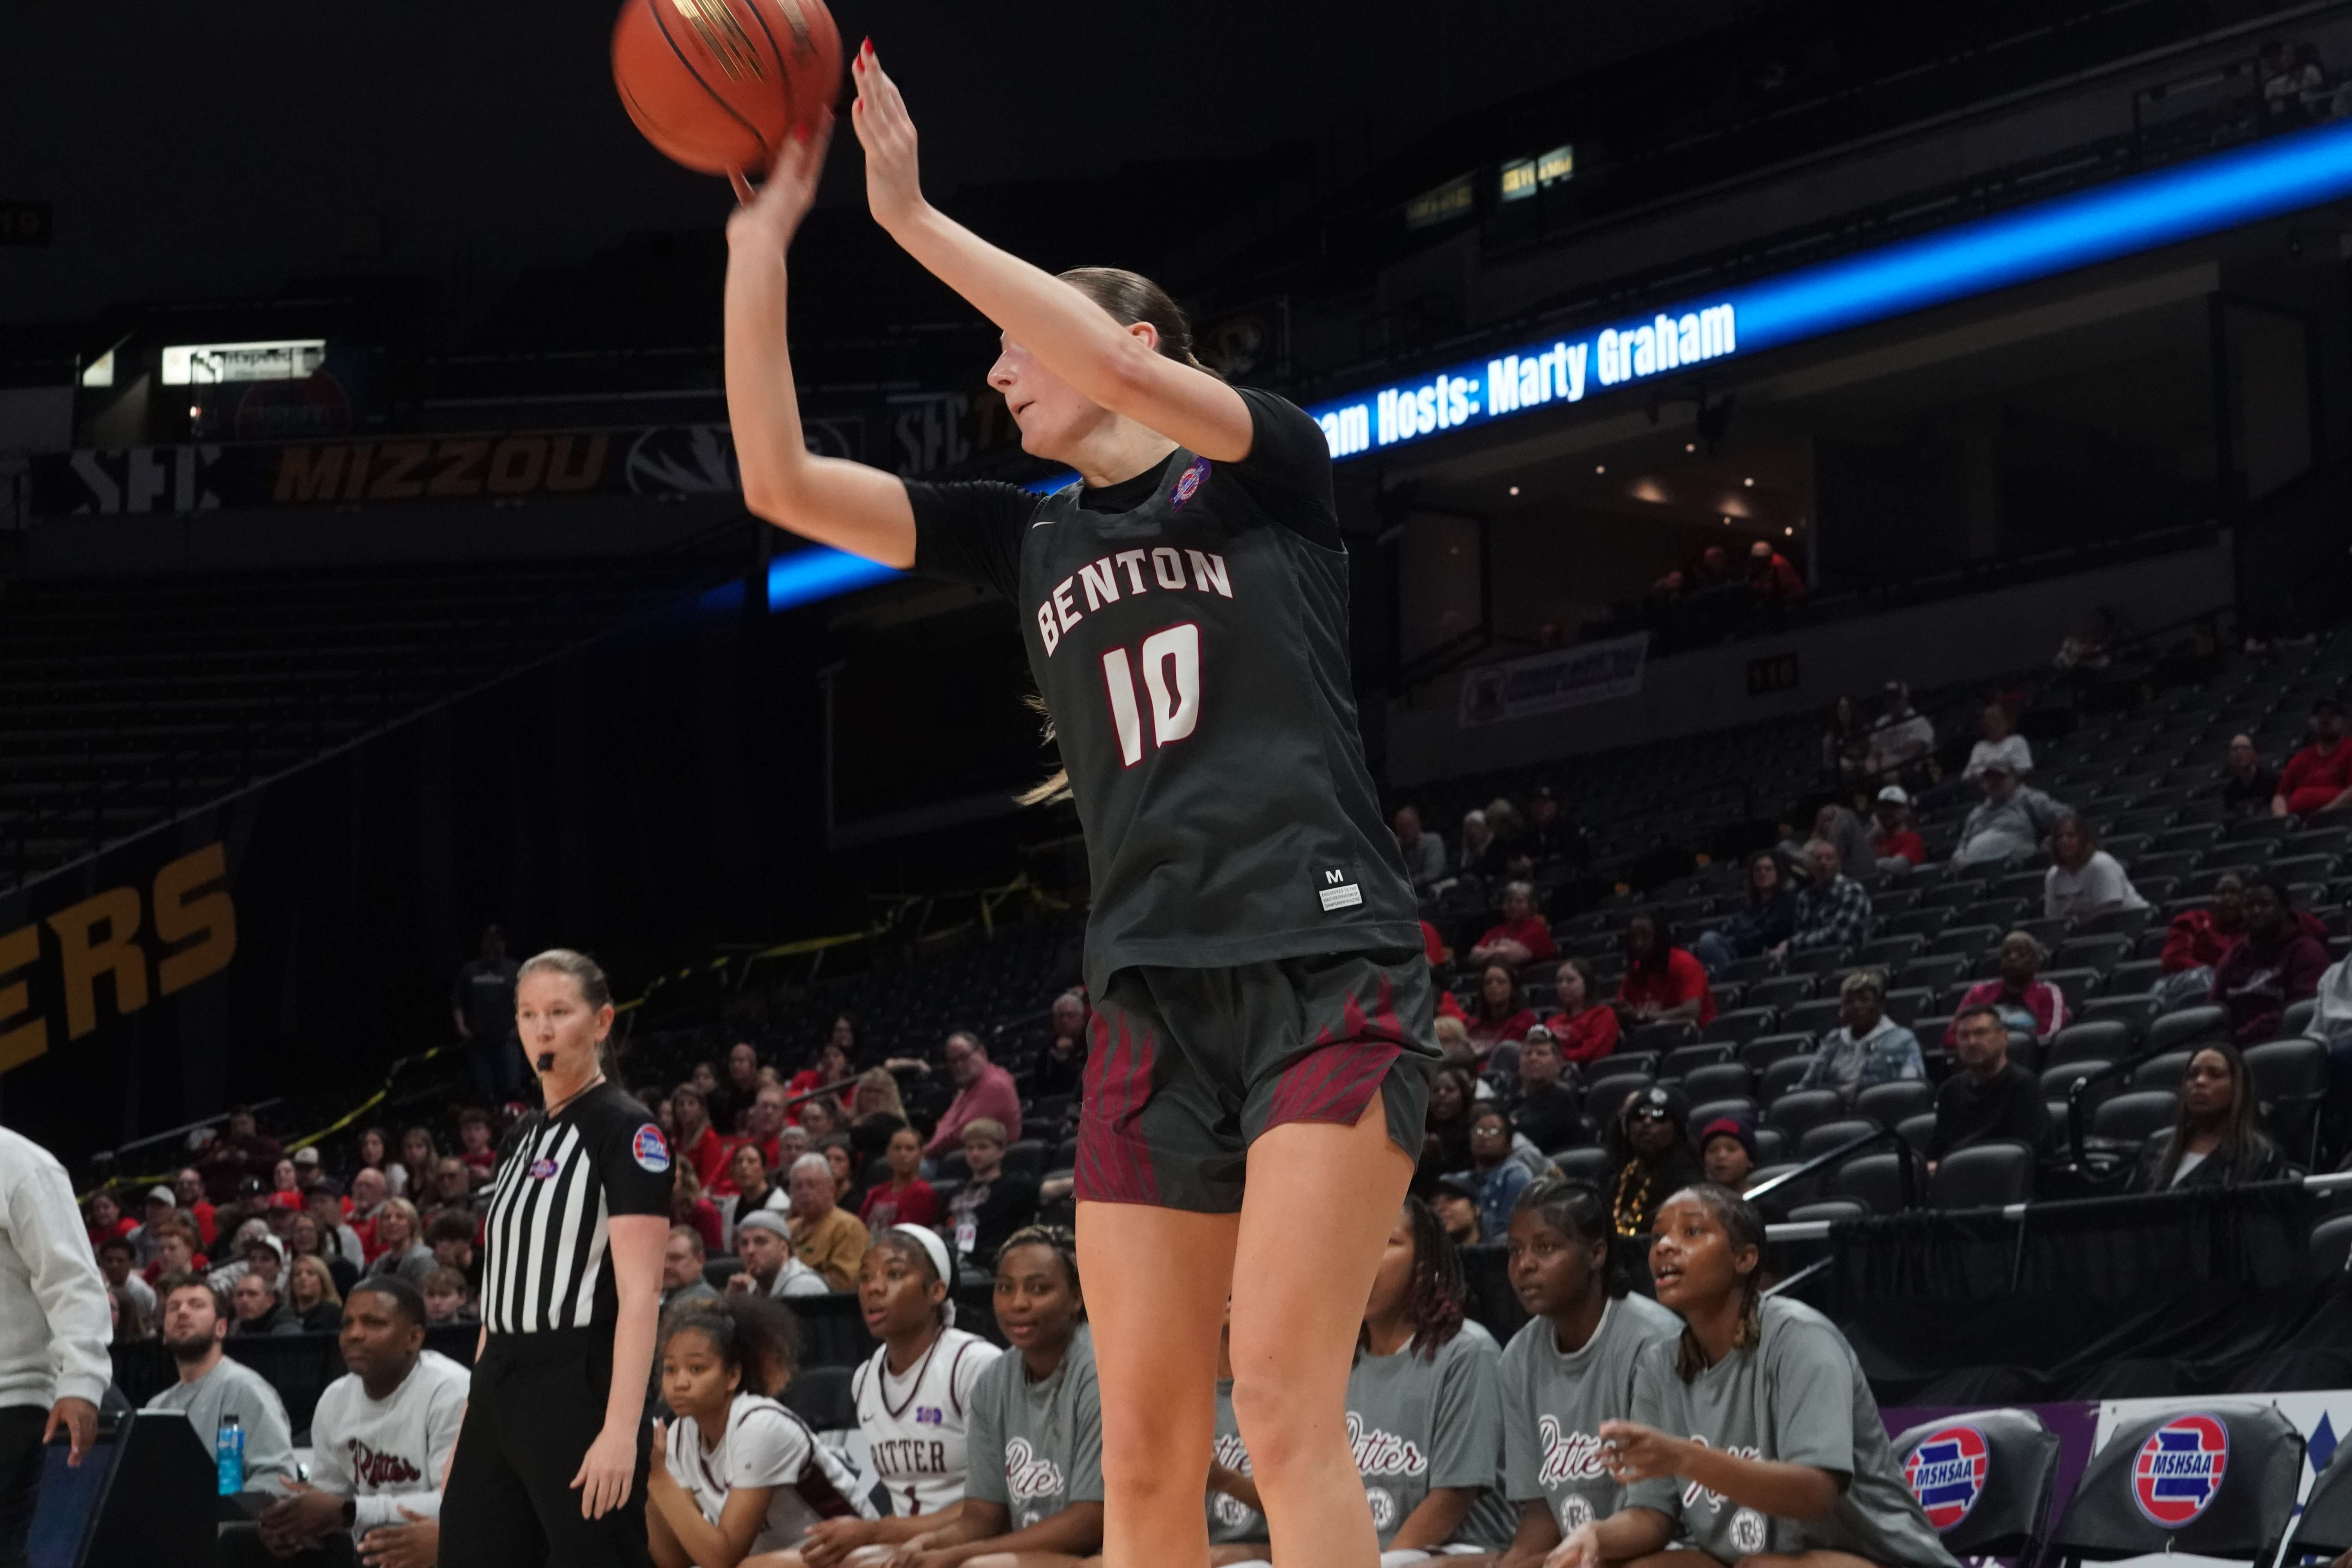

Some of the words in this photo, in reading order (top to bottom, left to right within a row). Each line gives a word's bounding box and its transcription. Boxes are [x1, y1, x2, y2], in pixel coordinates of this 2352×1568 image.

[1311, 404, 1369, 459] am
[1377, 374, 1480, 446] Hosts:
[1488, 341, 1589, 417] Marty
[1598, 303, 1736, 387] Graham
[271, 433, 610, 503] MIZZOU
[1038, 546, 1233, 658] BENTON
[1100, 621, 1201, 769] 10
[1325, 869, 1344, 884] M
[348, 1437, 421, 1488] Ritter
[1538, 1414, 1623, 1491] Ritte
[1916, 1460, 1972, 1486] MSHSAA
[2153, 1453, 2212, 1475] MSHSAA
